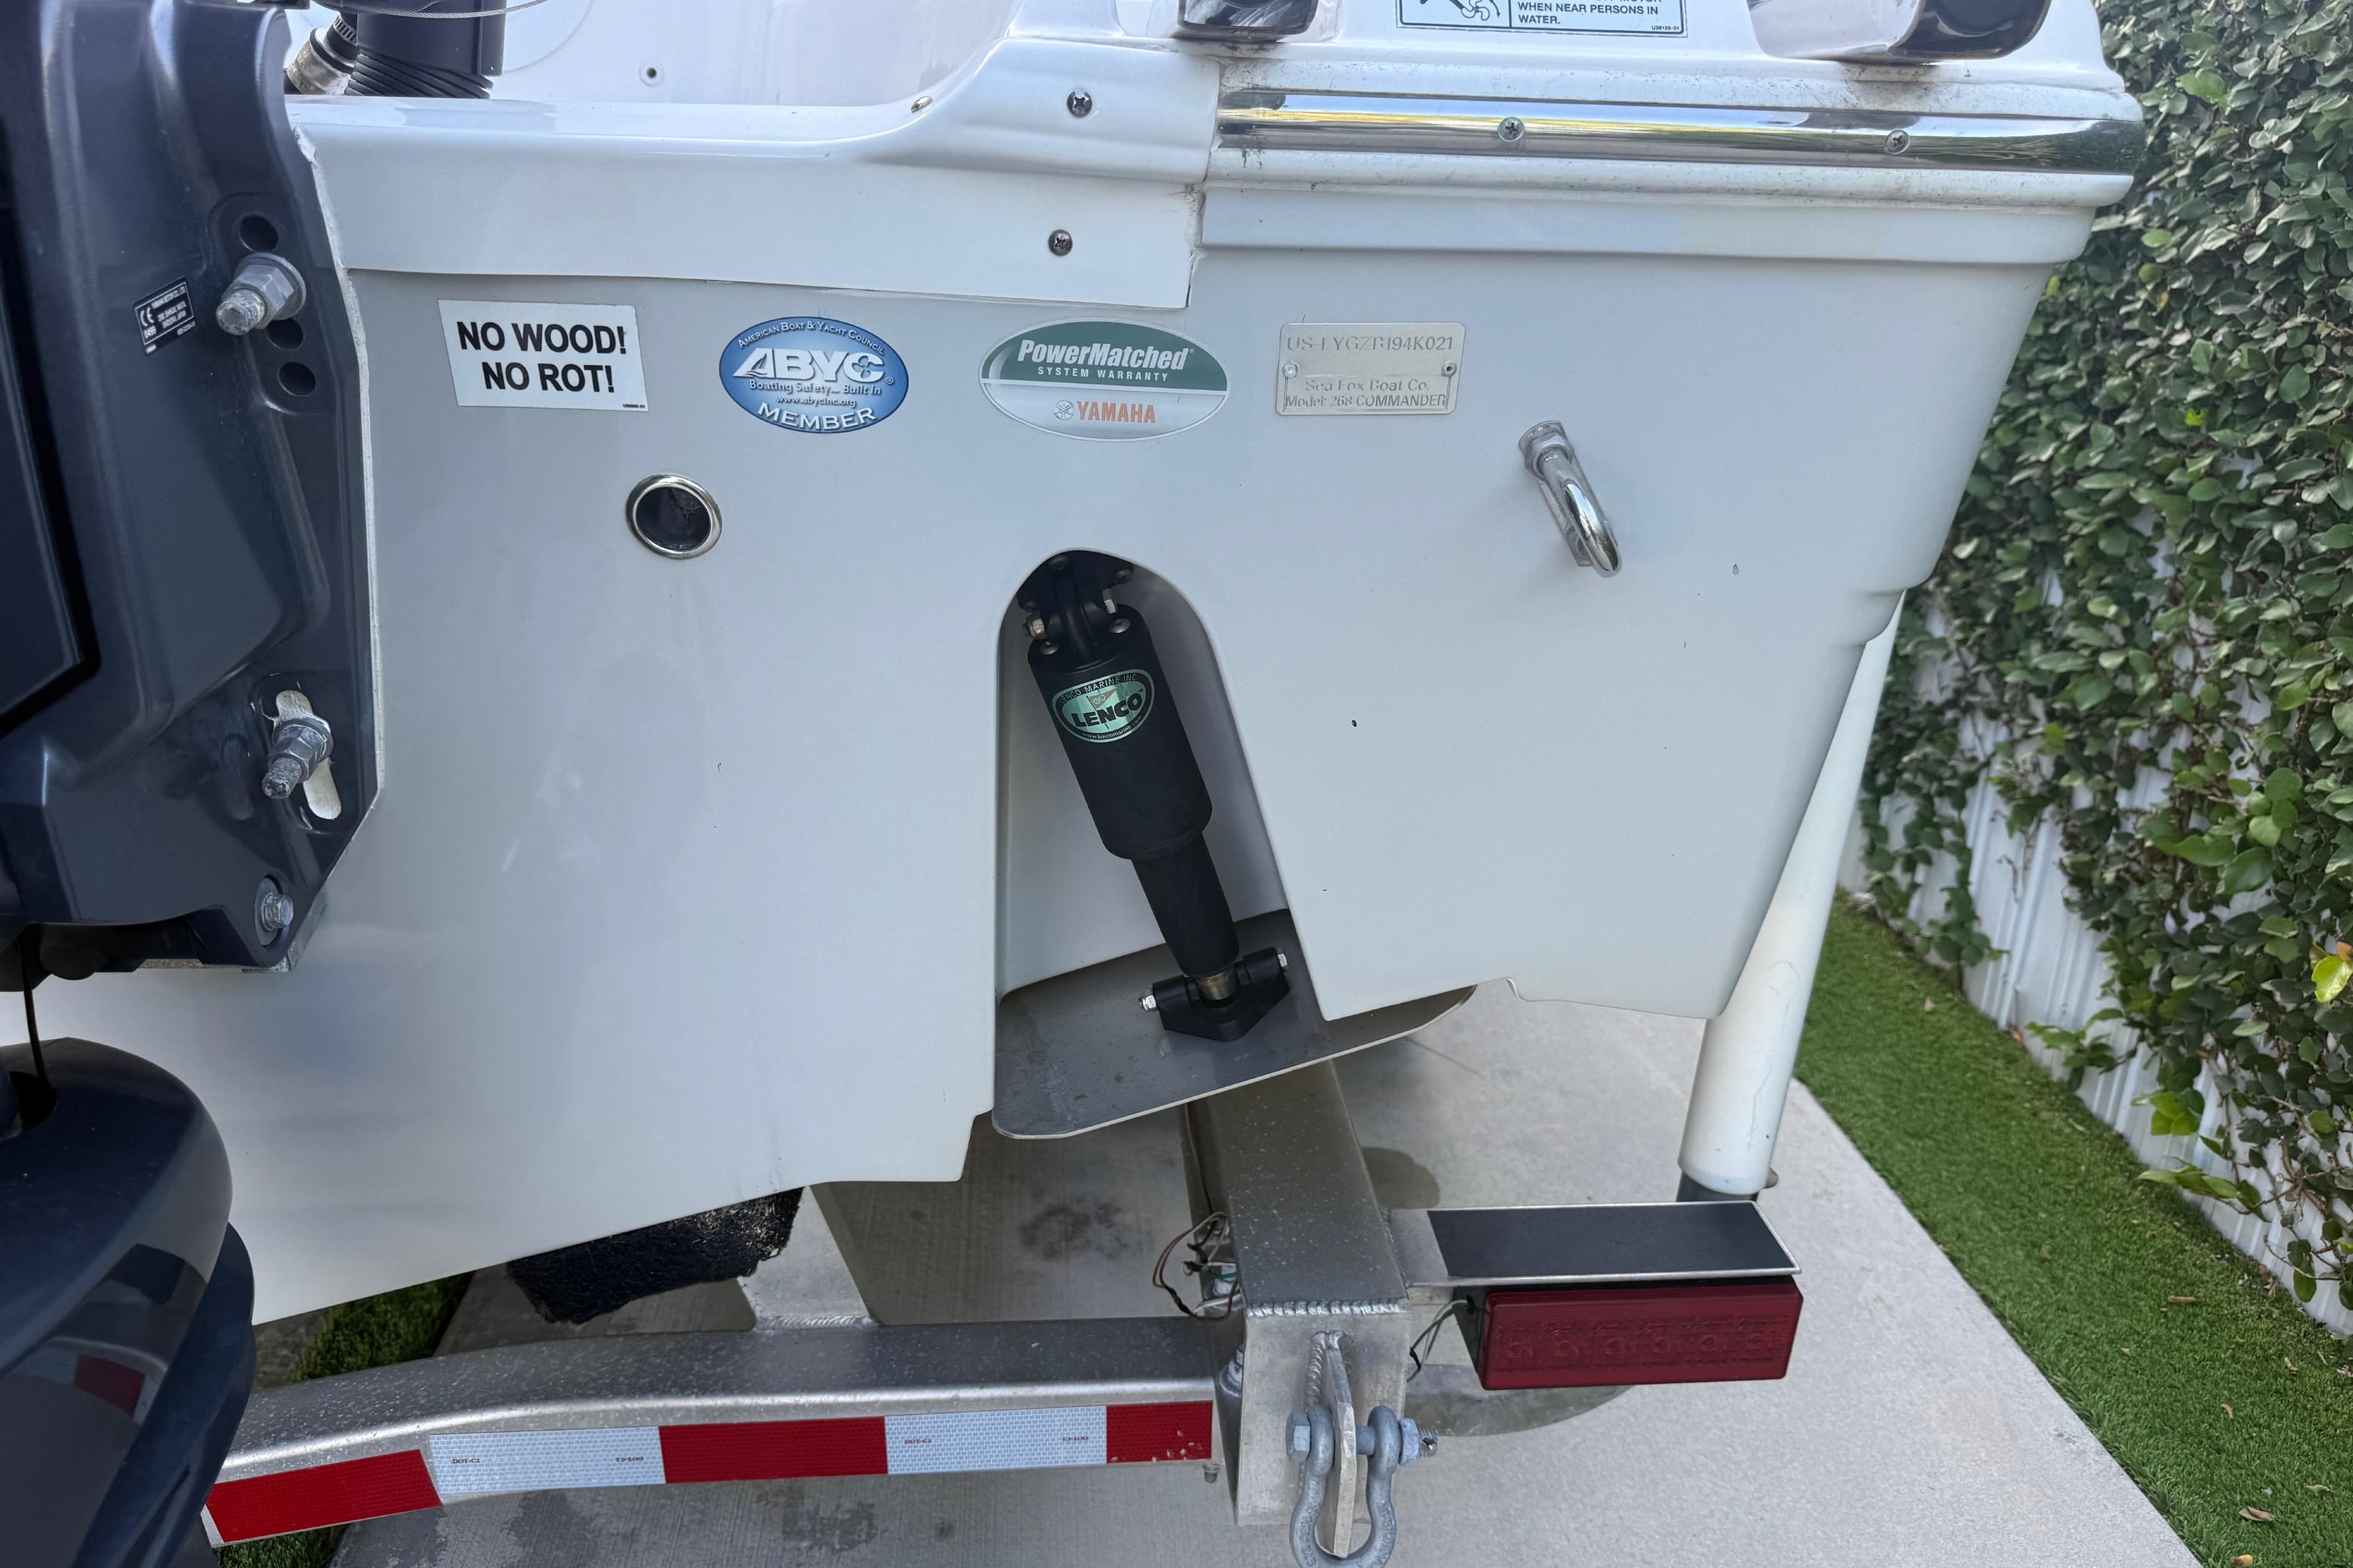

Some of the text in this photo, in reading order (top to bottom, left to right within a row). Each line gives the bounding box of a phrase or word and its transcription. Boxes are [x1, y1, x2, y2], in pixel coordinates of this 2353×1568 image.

[1518, 2, 1659, 15] WHEN NEAR PERSONS IN
[1518, 15, 1561, 25] WATER.
[807, 320, 814, 330] &
[457, 321, 626, 354] NO WOOD!
[733, 347, 884, 382] ABYC
[482, 362, 615, 393] NO ROT!
[1037, 366, 1169, 382] SYSTEM WARRANTY
[749, 379, 793, 393] Boating
[843, 384, 868, 395] Built
[870, 385, 882, 395] In
[1305, 379, 1430, 391] Sea Fox Boat Co.
[776, 395, 857, 407] www.abycinc.org
[1330, 395, 1353, 407] 268
[1356, 394, 1446, 407] COMMANDER
[757, 401, 877, 430] MEMBER
[1077, 401, 1156, 424] YAMAHA
[1059, 689, 1082, 704] LENCO
[1084, 676, 1120, 693] MARINE
[1071, 692, 1143, 727] LENCO
